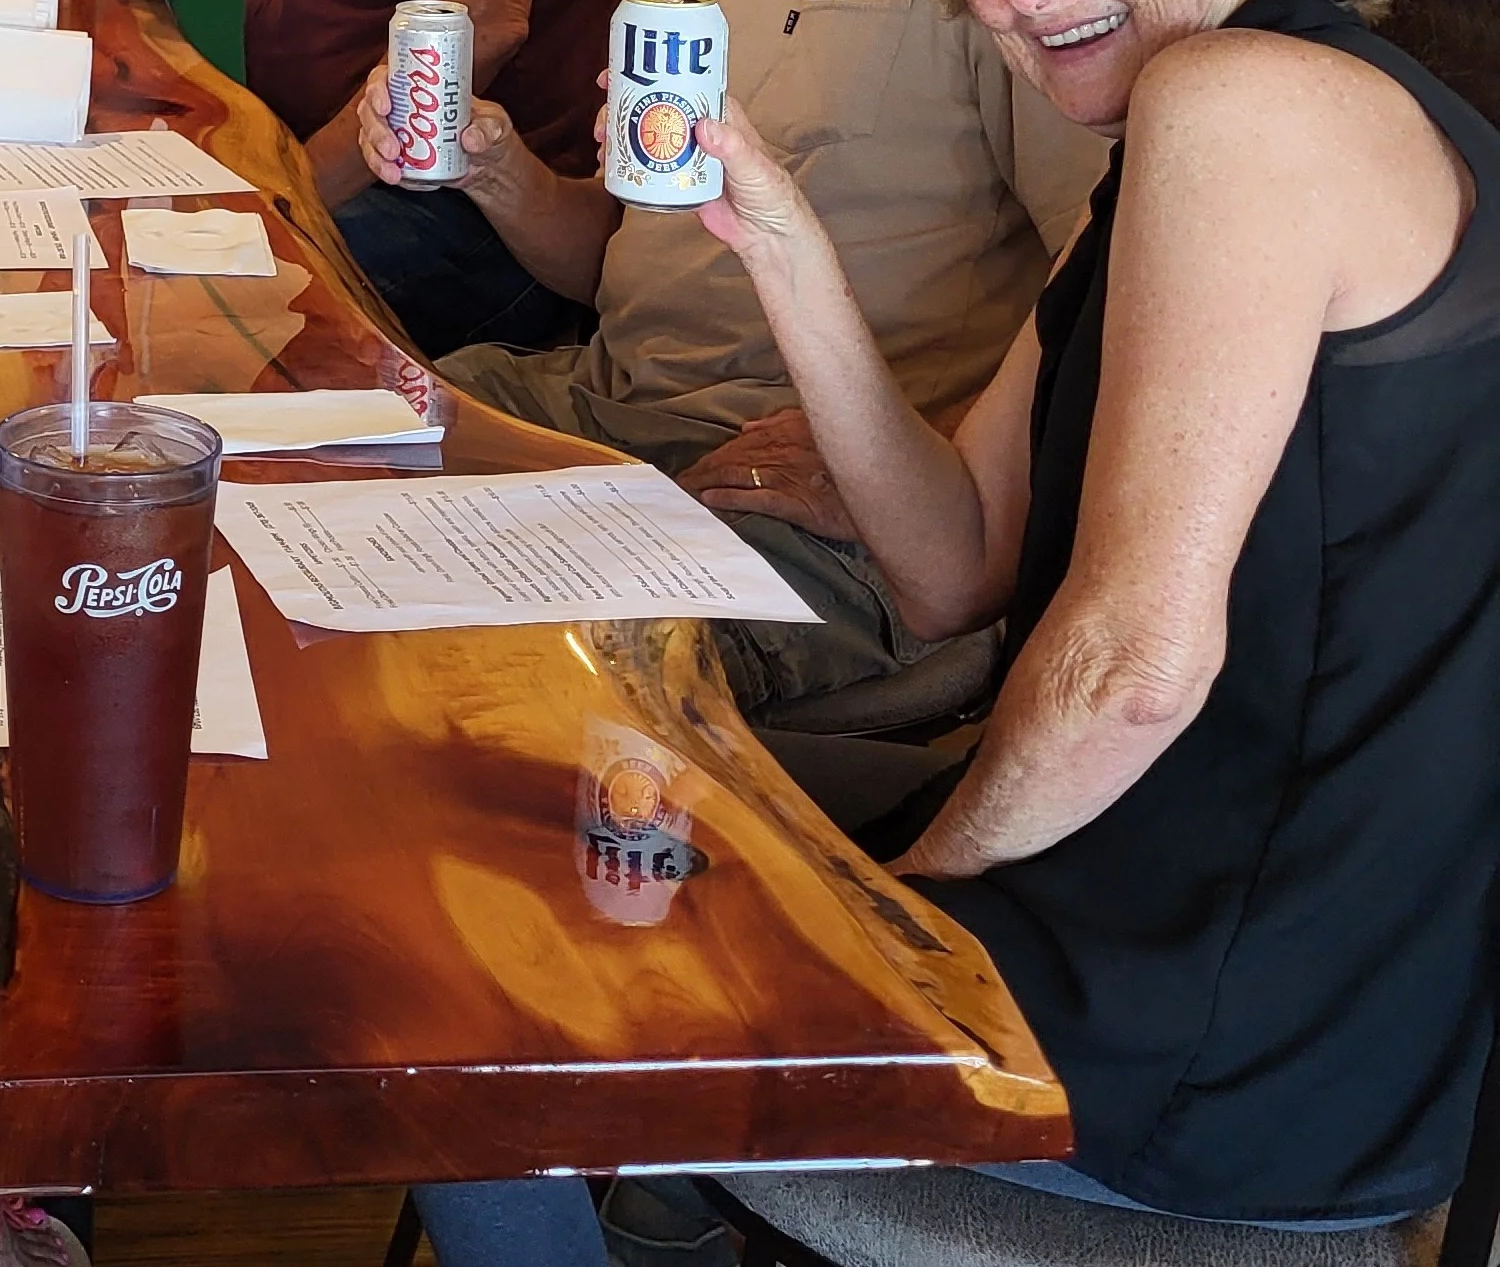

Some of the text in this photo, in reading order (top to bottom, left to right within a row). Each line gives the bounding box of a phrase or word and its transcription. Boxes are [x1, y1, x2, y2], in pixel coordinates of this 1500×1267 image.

[620, 21, 713, 87] Lite
[396, 44, 443, 172] Coors
[443, 78, 461, 145] LIGHT
[635, 93, 659, 114] FINE
